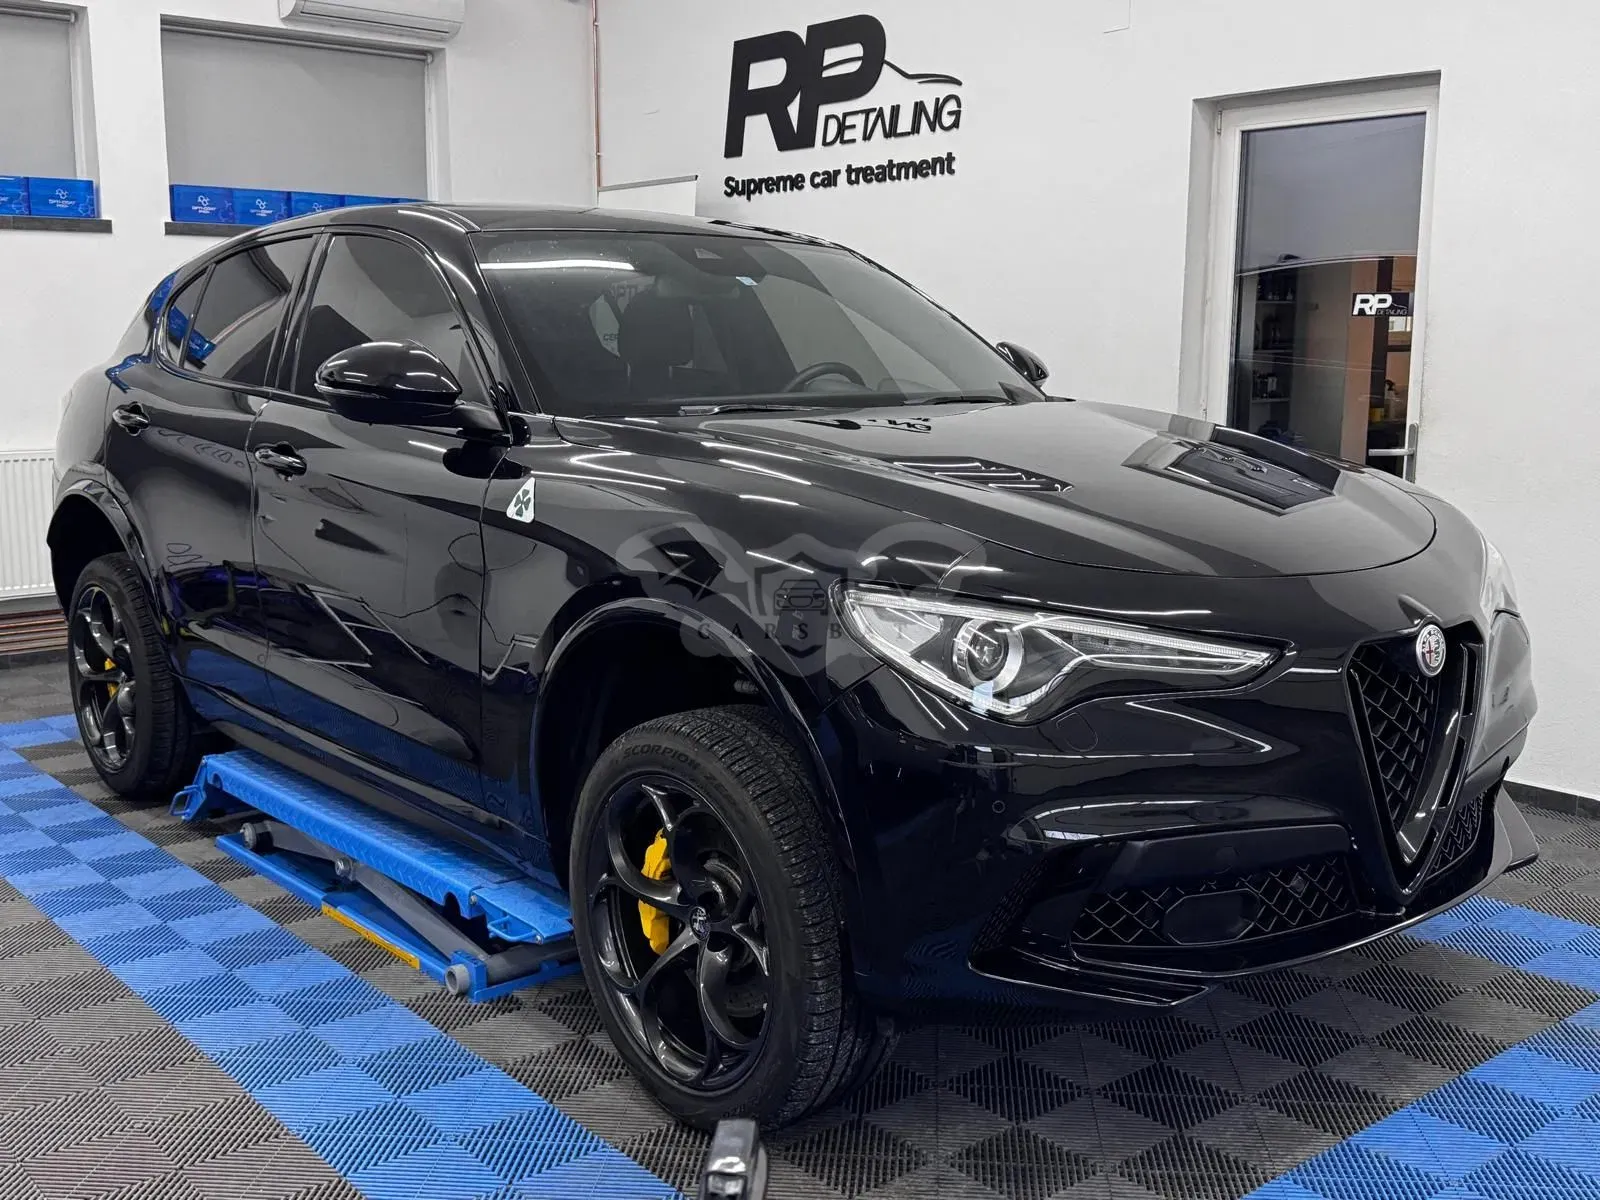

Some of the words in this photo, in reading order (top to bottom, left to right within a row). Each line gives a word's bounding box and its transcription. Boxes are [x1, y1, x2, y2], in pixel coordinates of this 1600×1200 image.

[724, 14, 886, 158] RP
[821, 94, 962, 147] DETAILING
[723, 173, 806, 202] Supreme
[809, 166, 842, 190] car
[845, 152, 956, 186] treatment
[1352, 294, 1392, 315] RP
[623, 744, 701, 771] SCORPION
